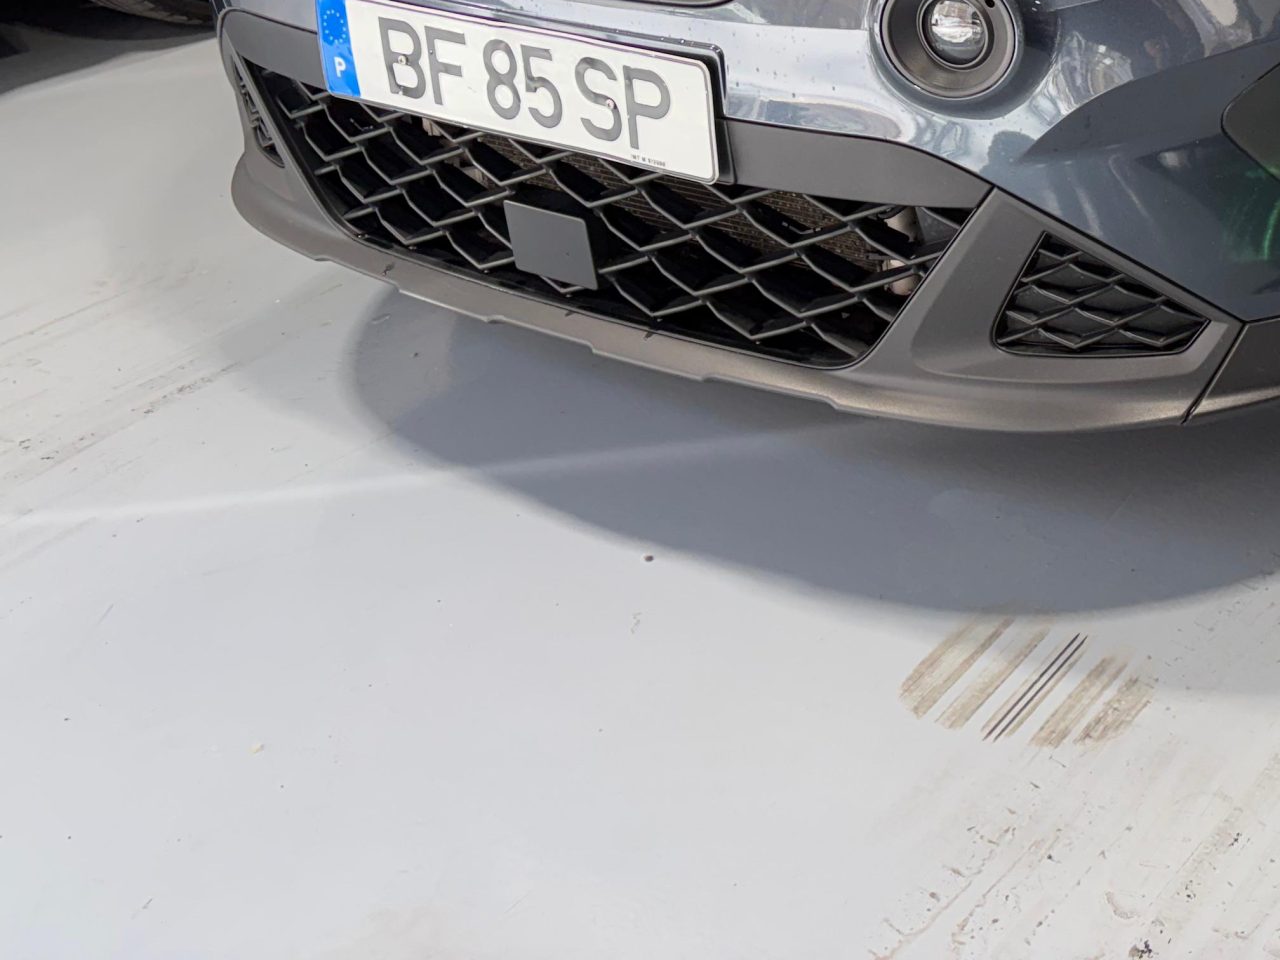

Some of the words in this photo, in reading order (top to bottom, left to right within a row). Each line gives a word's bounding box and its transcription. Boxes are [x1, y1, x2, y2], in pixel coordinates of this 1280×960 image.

[335, 57, 346, 78] P
[378, 16, 466, 106] BF
[482, 38, 563, 130] 85
[574, 56, 672, 151] SP
